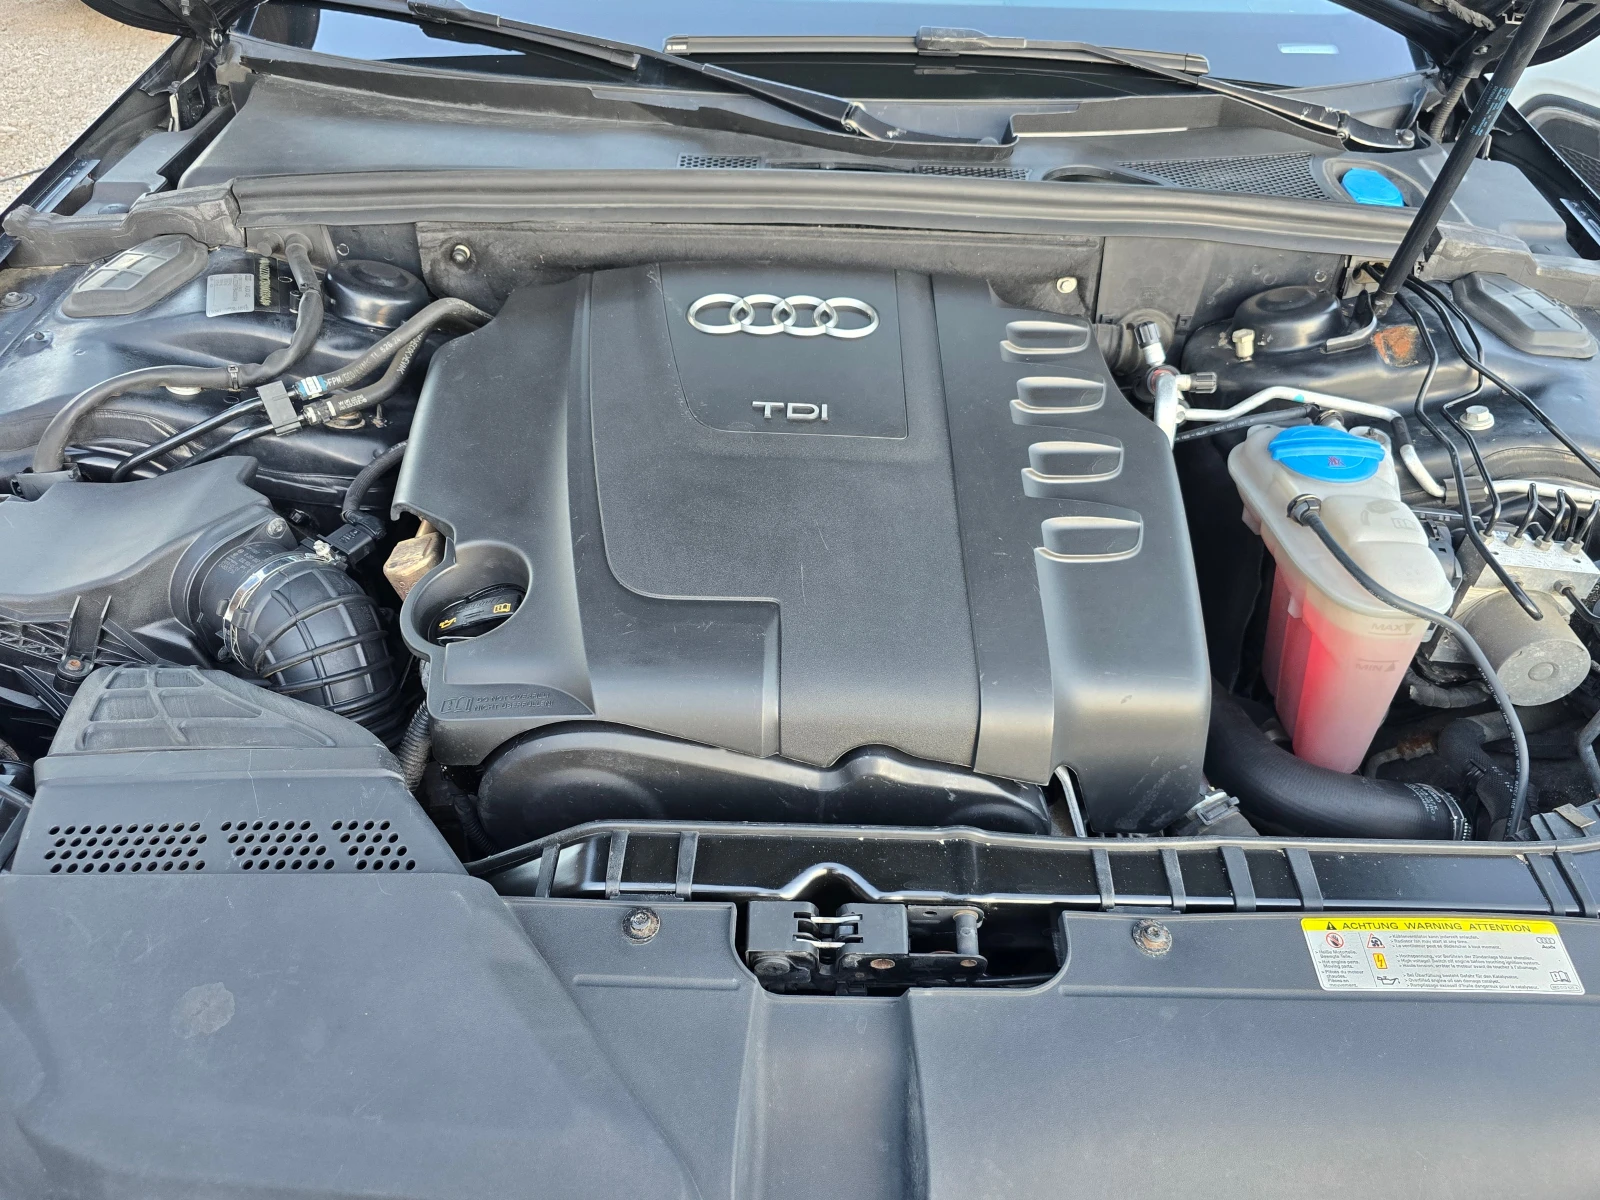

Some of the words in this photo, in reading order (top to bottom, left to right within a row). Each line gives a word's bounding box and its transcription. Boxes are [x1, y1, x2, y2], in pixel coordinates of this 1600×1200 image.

[752, 401, 829, 421] TDI
[1370, 623, 1404, 632] MAX
[1355, 663, 1384, 672] MIN
[491, 694, 509, 702] NOT
[1342, 922, 1399, 930] ACHTUNG
[1404, 922, 1463, 930] WARNING
[1469, 923, 1532, 932] ATTENTION
